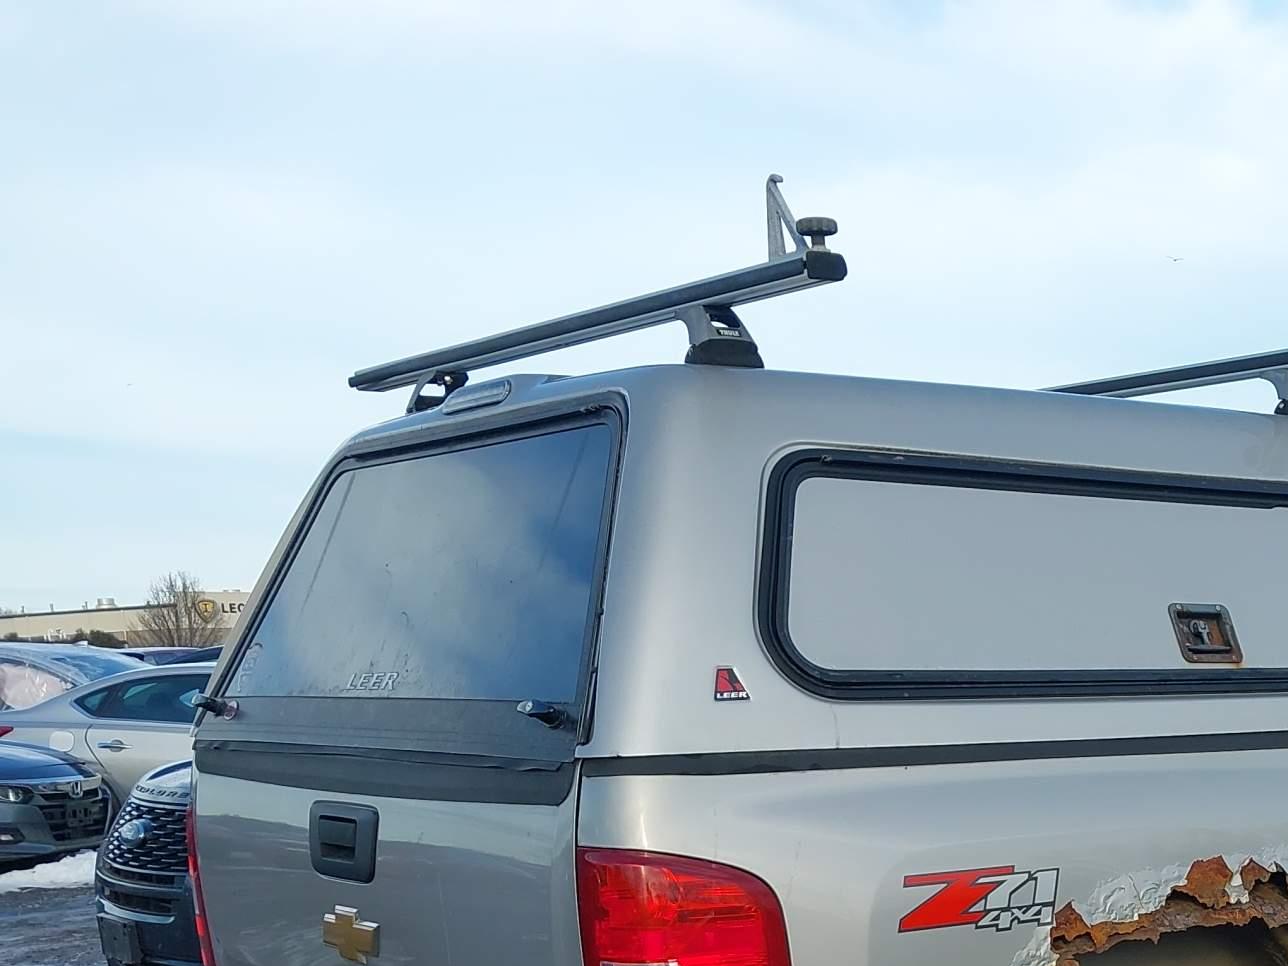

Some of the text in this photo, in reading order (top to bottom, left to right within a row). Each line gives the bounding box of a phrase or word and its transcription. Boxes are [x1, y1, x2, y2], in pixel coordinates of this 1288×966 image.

[344, 672, 400, 691] LEER
[716, 691, 748, 699] LEER
[898, 864, 1060, 933] Z71
